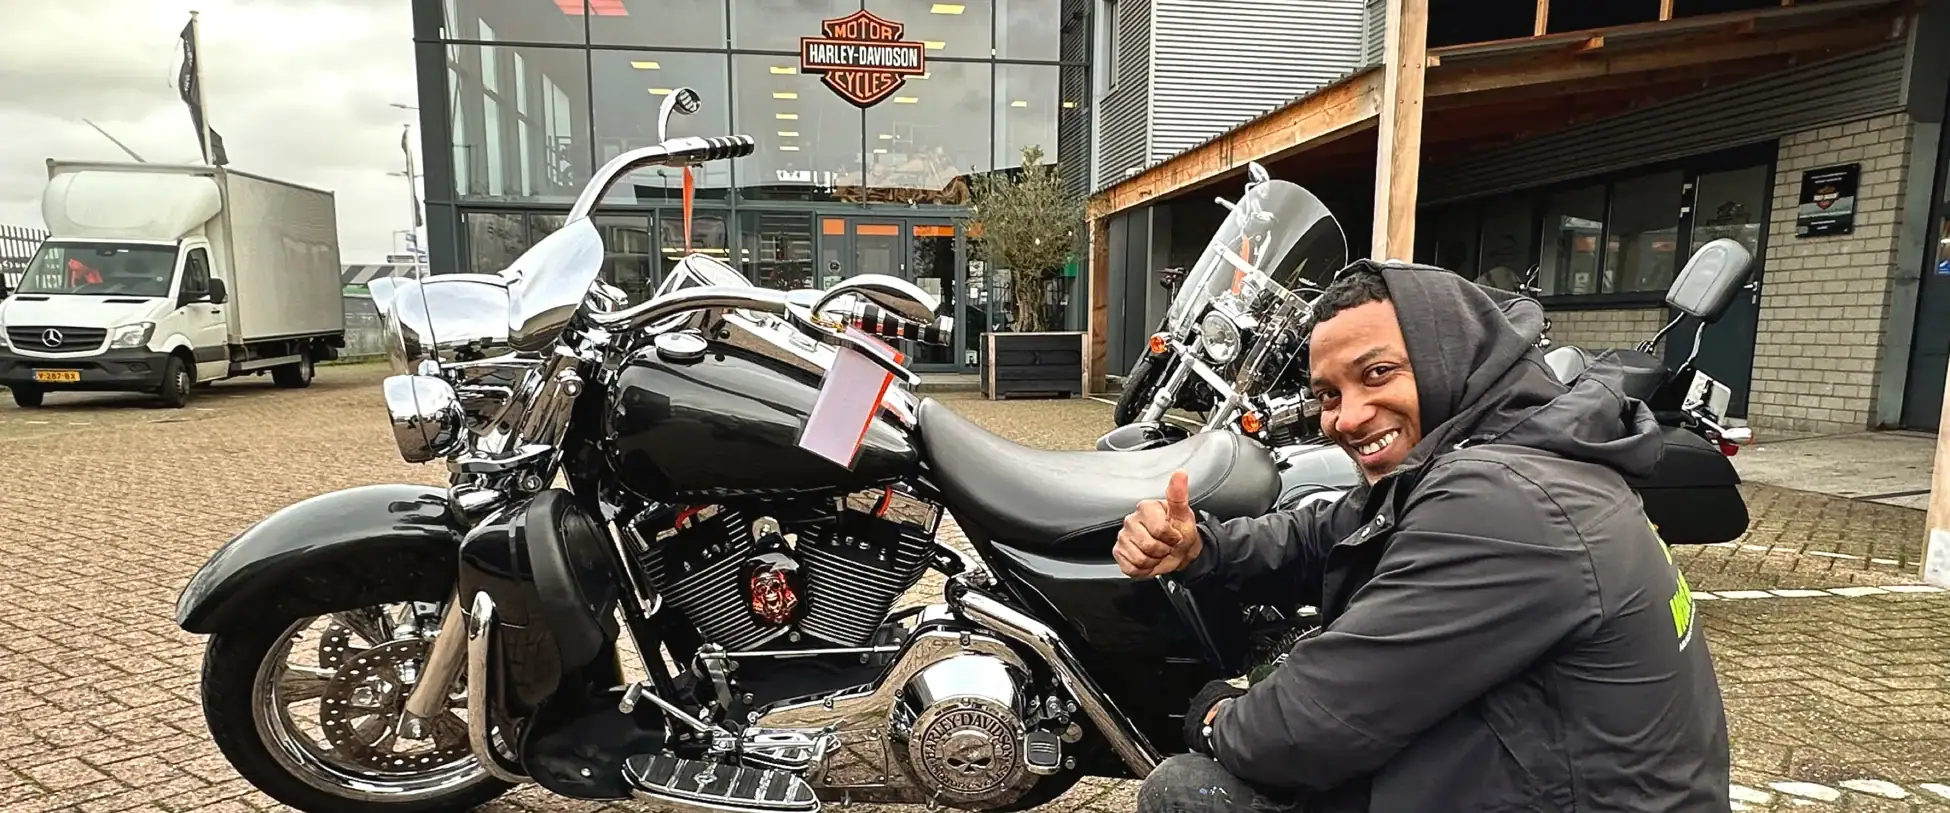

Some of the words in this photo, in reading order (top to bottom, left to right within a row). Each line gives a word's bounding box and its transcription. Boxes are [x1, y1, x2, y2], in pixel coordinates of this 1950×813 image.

[834, 17, 892, 40] MOTOR
[809, 43, 918, 67] HARLEY-DAVIDSON
[834, 71, 892, 98] CYCLES
